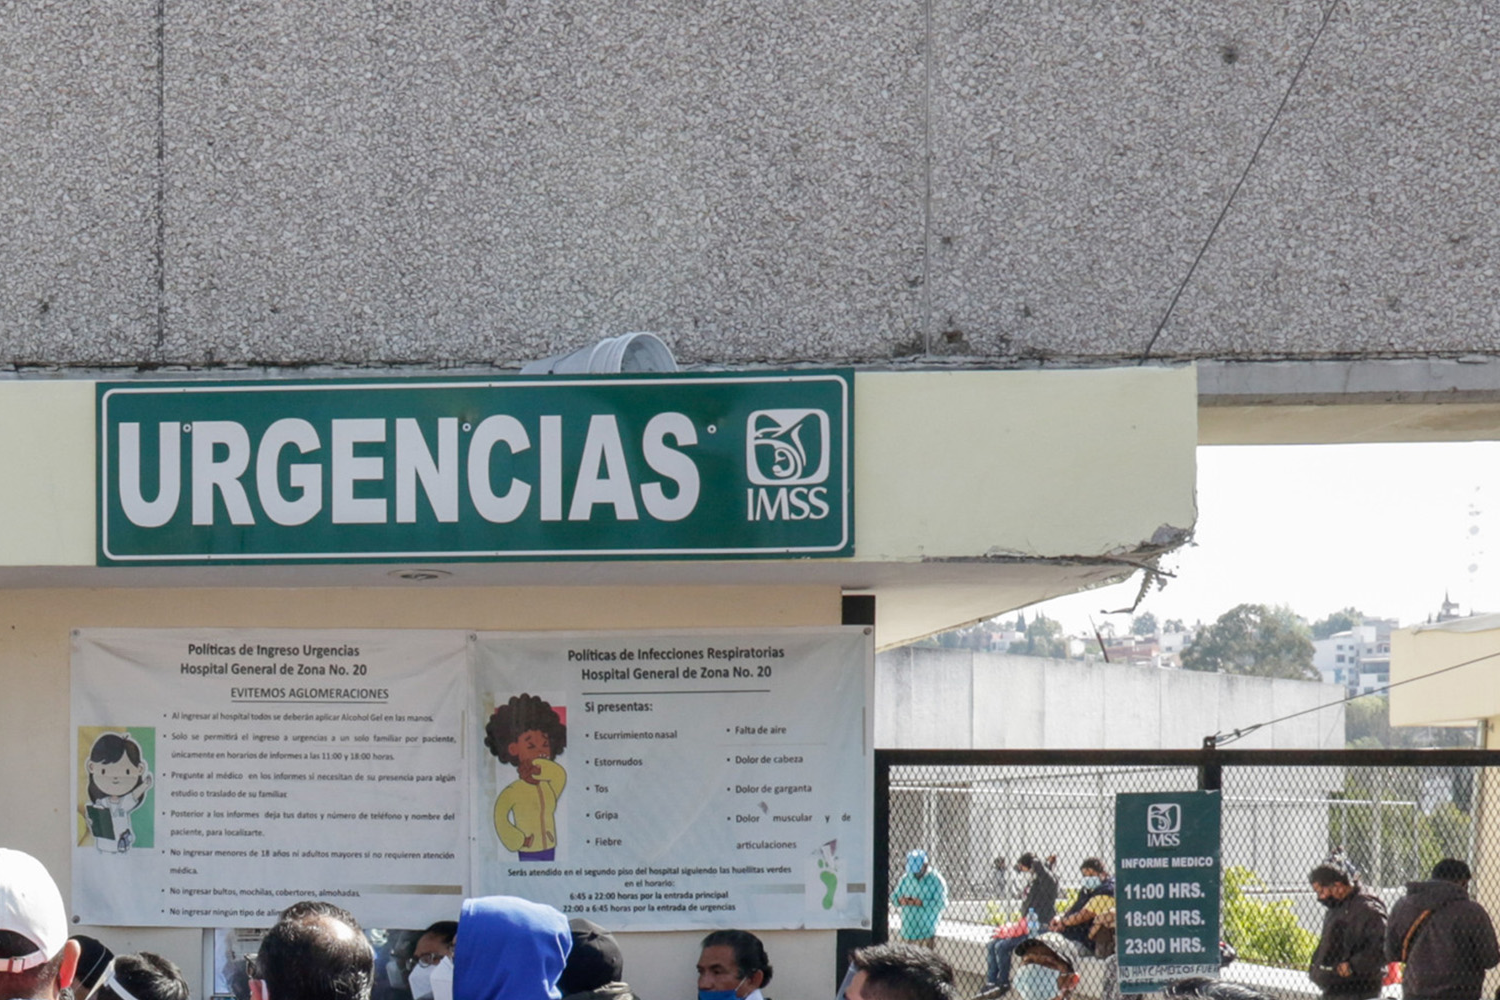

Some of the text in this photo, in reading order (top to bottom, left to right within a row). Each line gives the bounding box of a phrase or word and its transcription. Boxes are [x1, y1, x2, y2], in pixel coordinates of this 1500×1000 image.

[118, 412, 700, 528] URGENCIAS
[747, 487, 828, 521] IMSS
[188, 643, 360, 659] Políticas de Ingreso Urgencias
[567, 645, 785, 661] Políticas de Infecciones Respiratorias
[180, 662, 367, 676] Hospital General de Zona No. 20
[581, 665, 772, 682] Hospital General de Zona No. 20
[230, 687, 389, 699] EVITEMOS AGLOMERACIONES
[584, 701, 653, 714] Si presentas:
[593, 730, 677, 740] Escurrimiento nasal
[734, 725, 786, 735] Falta de aire
[171, 731, 188, 740] Solo
[203, 732, 238, 742] permitirá
[241, 733, 249, 741] el
[252, 733, 280, 743] ingreso
[291, 734, 327, 743] urgencias
[353, 734, 370, 742] solo
[372, 733, 402, 742] familiar
[404, 736, 418, 746] por
[593, 757, 643, 767] Estornudos
[734, 754, 803, 764] Dolor de cabeza
[594, 784, 609, 793] Tos
[735, 784, 812, 795] Dolor de garganta
[594, 810, 618, 821] Gripa
[735, 813, 851, 823] Dolor muscular y de
[594, 837, 622, 846] Fiebre
[735, 839, 797, 850] articulaciones
[1147, 833, 1180, 847] IMSS
[169, 848, 181, 856] No
[182, 848, 213, 858] ingresar
[248, 849, 258, 857] de
[260, 849, 270, 857] 18
[272, 849, 290, 858] años
[301, 849, 329, 858] adultos
[330, 851, 362, 860] mayores
[384, 851, 421, 860] requieren
[422, 851, 455, 860] atención
[1121, 856, 1213, 868] INFORME MEDICO
[528, 867, 562, 876] atendido
[574, 867, 582, 876] el
[583, 867, 616, 877] segundo
[617, 867, 633, 876] piso
[635, 867, 647, 876] del
[648, 867, 679, 877] hospital
[680, 866, 718, 876] siguiendo
[718, 866, 730, 874] las
[766, 865, 791, 873] verdes
[635, 879, 643, 887] el
[181, 888, 211, 896] ingresar
[569, 892, 586, 900] 6:45
[594, 891, 615, 900] 22:00
[616, 891, 638, 900] horas
[640, 893, 653, 902] por
[654, 891, 662, 899] la
[663, 891, 693, 899] entrada
[694, 890, 729, 900] principal
[1124, 883, 1205, 899] 11:00 HRS.
[563, 905, 584, 913] 22:00
[591, 904, 608, 912] 6:45
[609, 904, 631, 912] horas
[633, 905, 646, 914] por
[647, 903, 655, 912] la
[656, 903, 687, 912] entrada
[688, 903, 698, 911] de
[699, 904, 736, 913] urgencias
[1124, 910, 1205, 926] 18:00 HRS.
[1125, 937, 1205, 954] 23:00 HRS.
